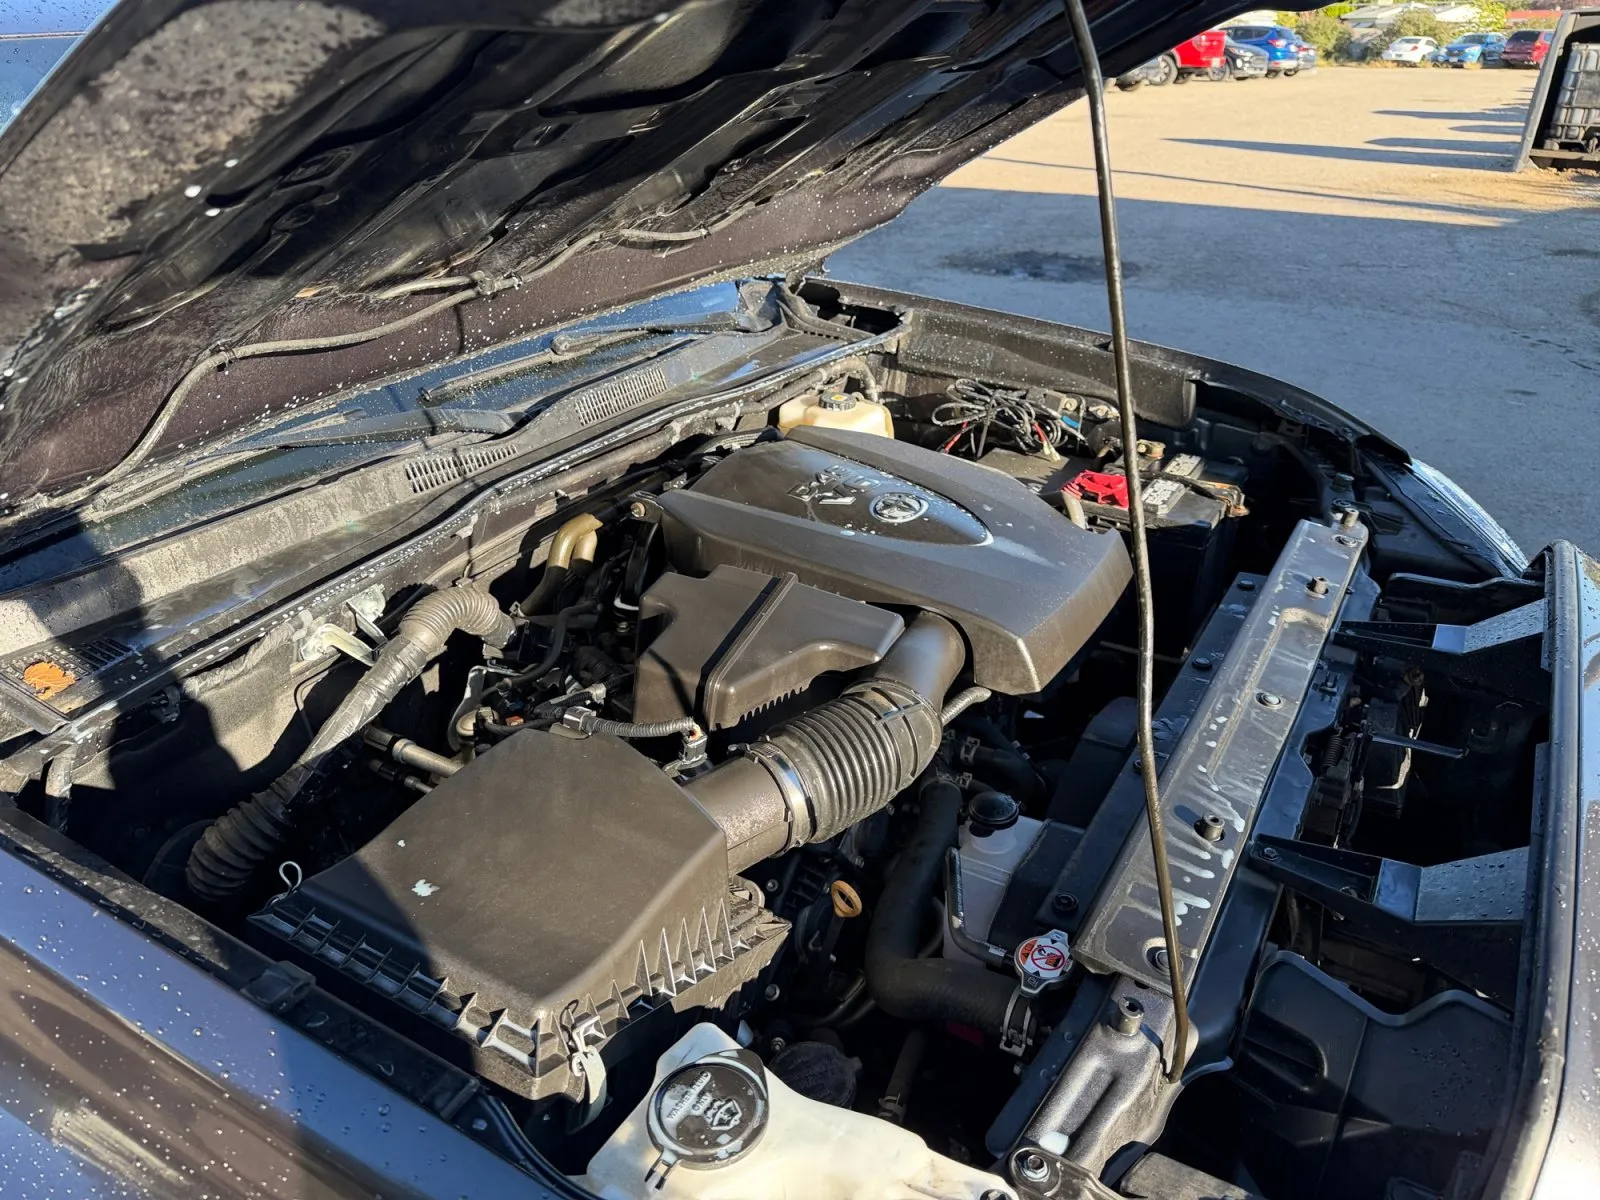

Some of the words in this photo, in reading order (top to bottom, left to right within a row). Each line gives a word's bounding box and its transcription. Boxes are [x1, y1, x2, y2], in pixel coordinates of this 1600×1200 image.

[818, 475, 881, 505] V6
[666, 1089, 693, 1120] WASHER
[690, 1070, 712, 1095] FLUID
[691, 1091, 713, 1113] ONLY
